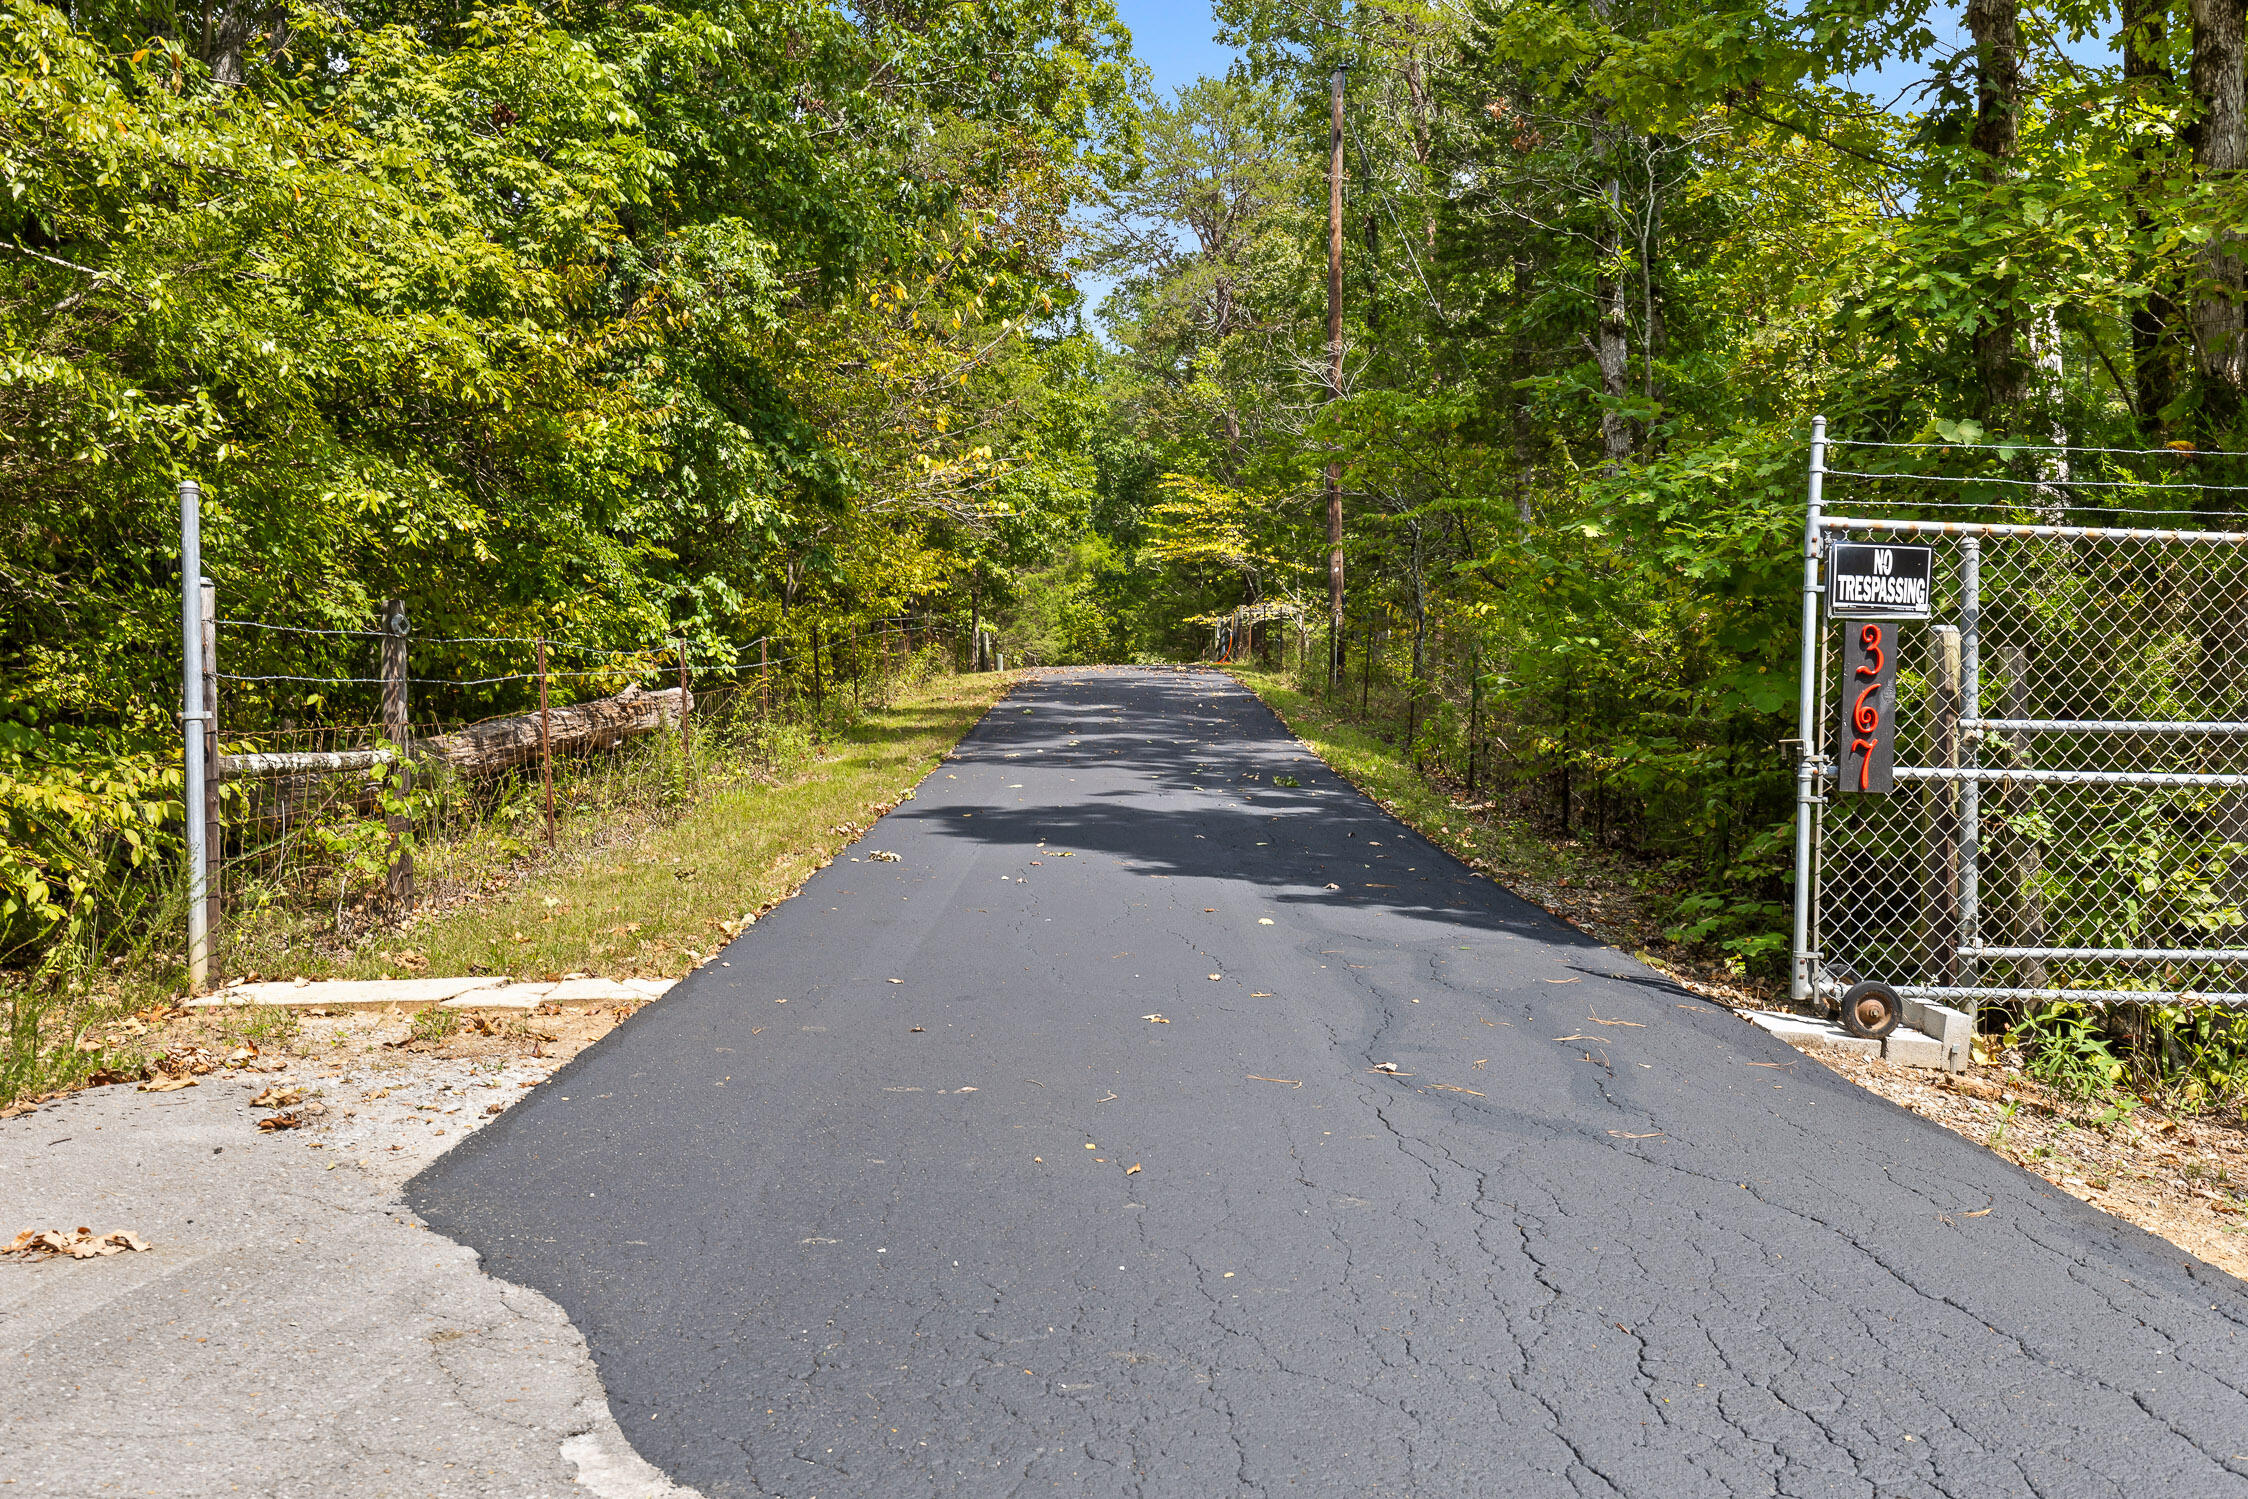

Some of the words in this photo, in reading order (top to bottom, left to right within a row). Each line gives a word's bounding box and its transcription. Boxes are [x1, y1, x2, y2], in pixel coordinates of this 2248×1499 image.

[1873, 549, 1893, 575] NO
[1838, 575, 1926, 604] TRESPASSING
[1851, 624, 1884, 789] 367
